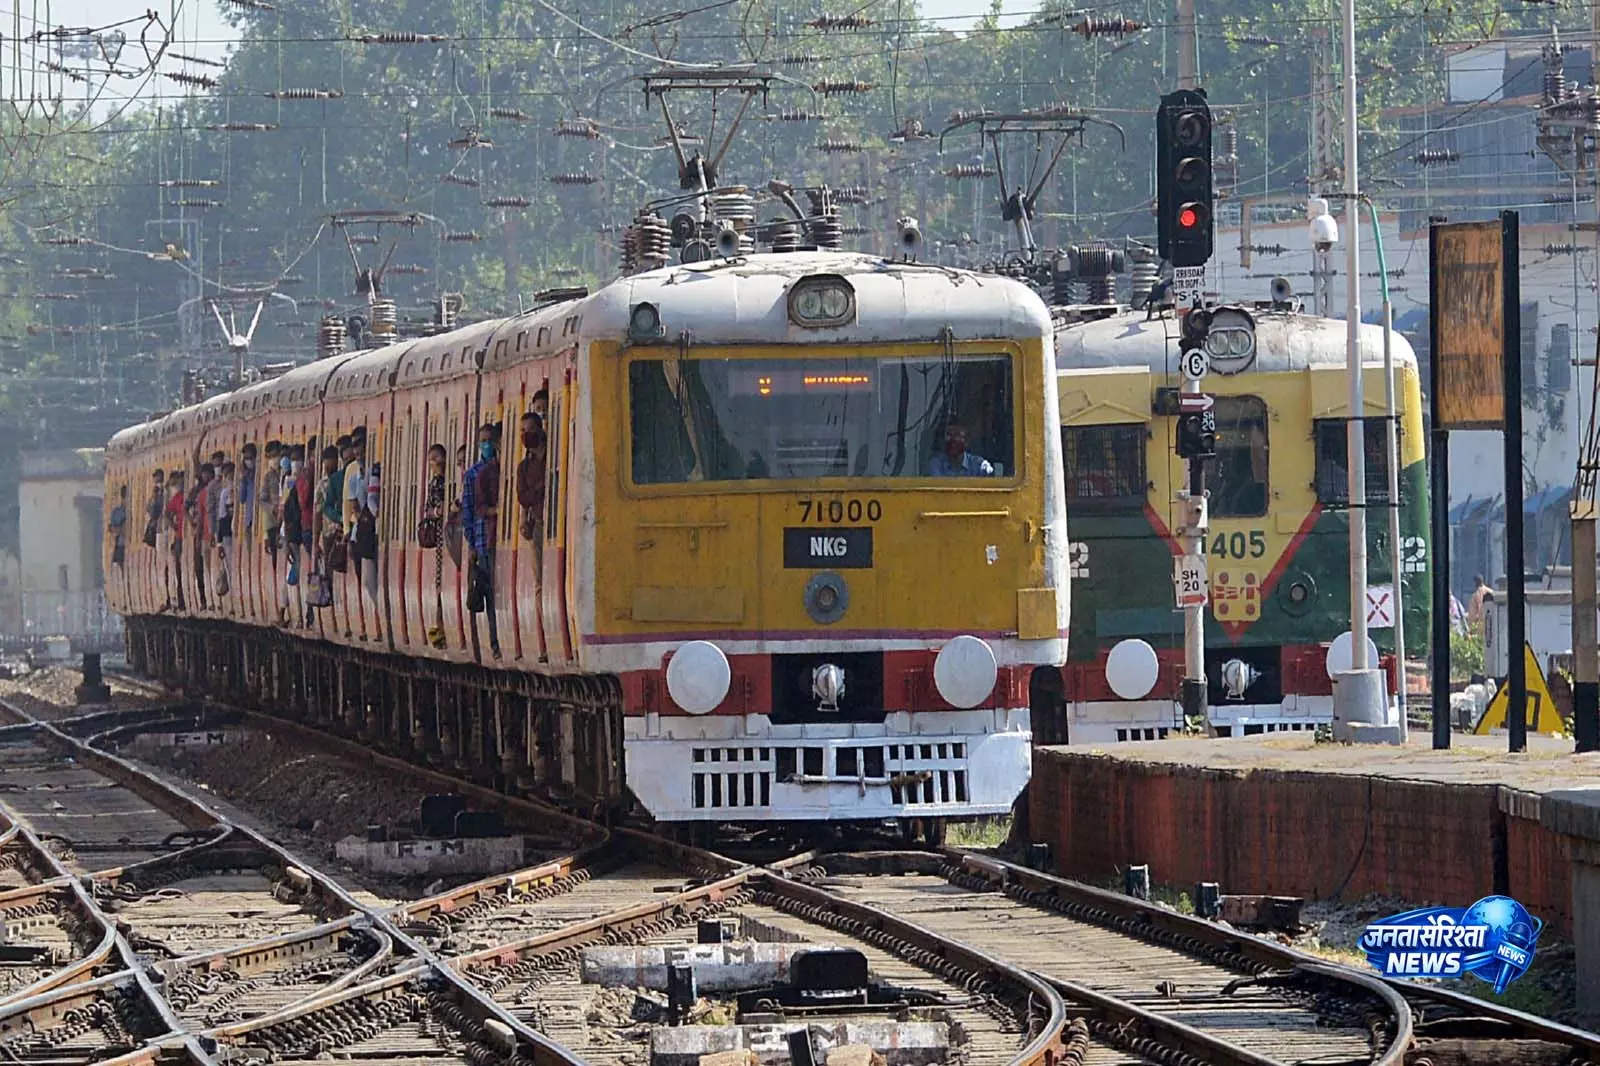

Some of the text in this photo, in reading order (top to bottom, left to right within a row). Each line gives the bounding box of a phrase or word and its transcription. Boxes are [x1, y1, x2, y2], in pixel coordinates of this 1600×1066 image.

[1203, 410, 1215, 420] SH
[1202, 420, 1215, 431] 20
[798, 500, 882, 523] 71000
[810, 537, 847, 557] NKG
[1182, 570, 1199, 580] SH
[1184, 581, 1200, 592] 20
